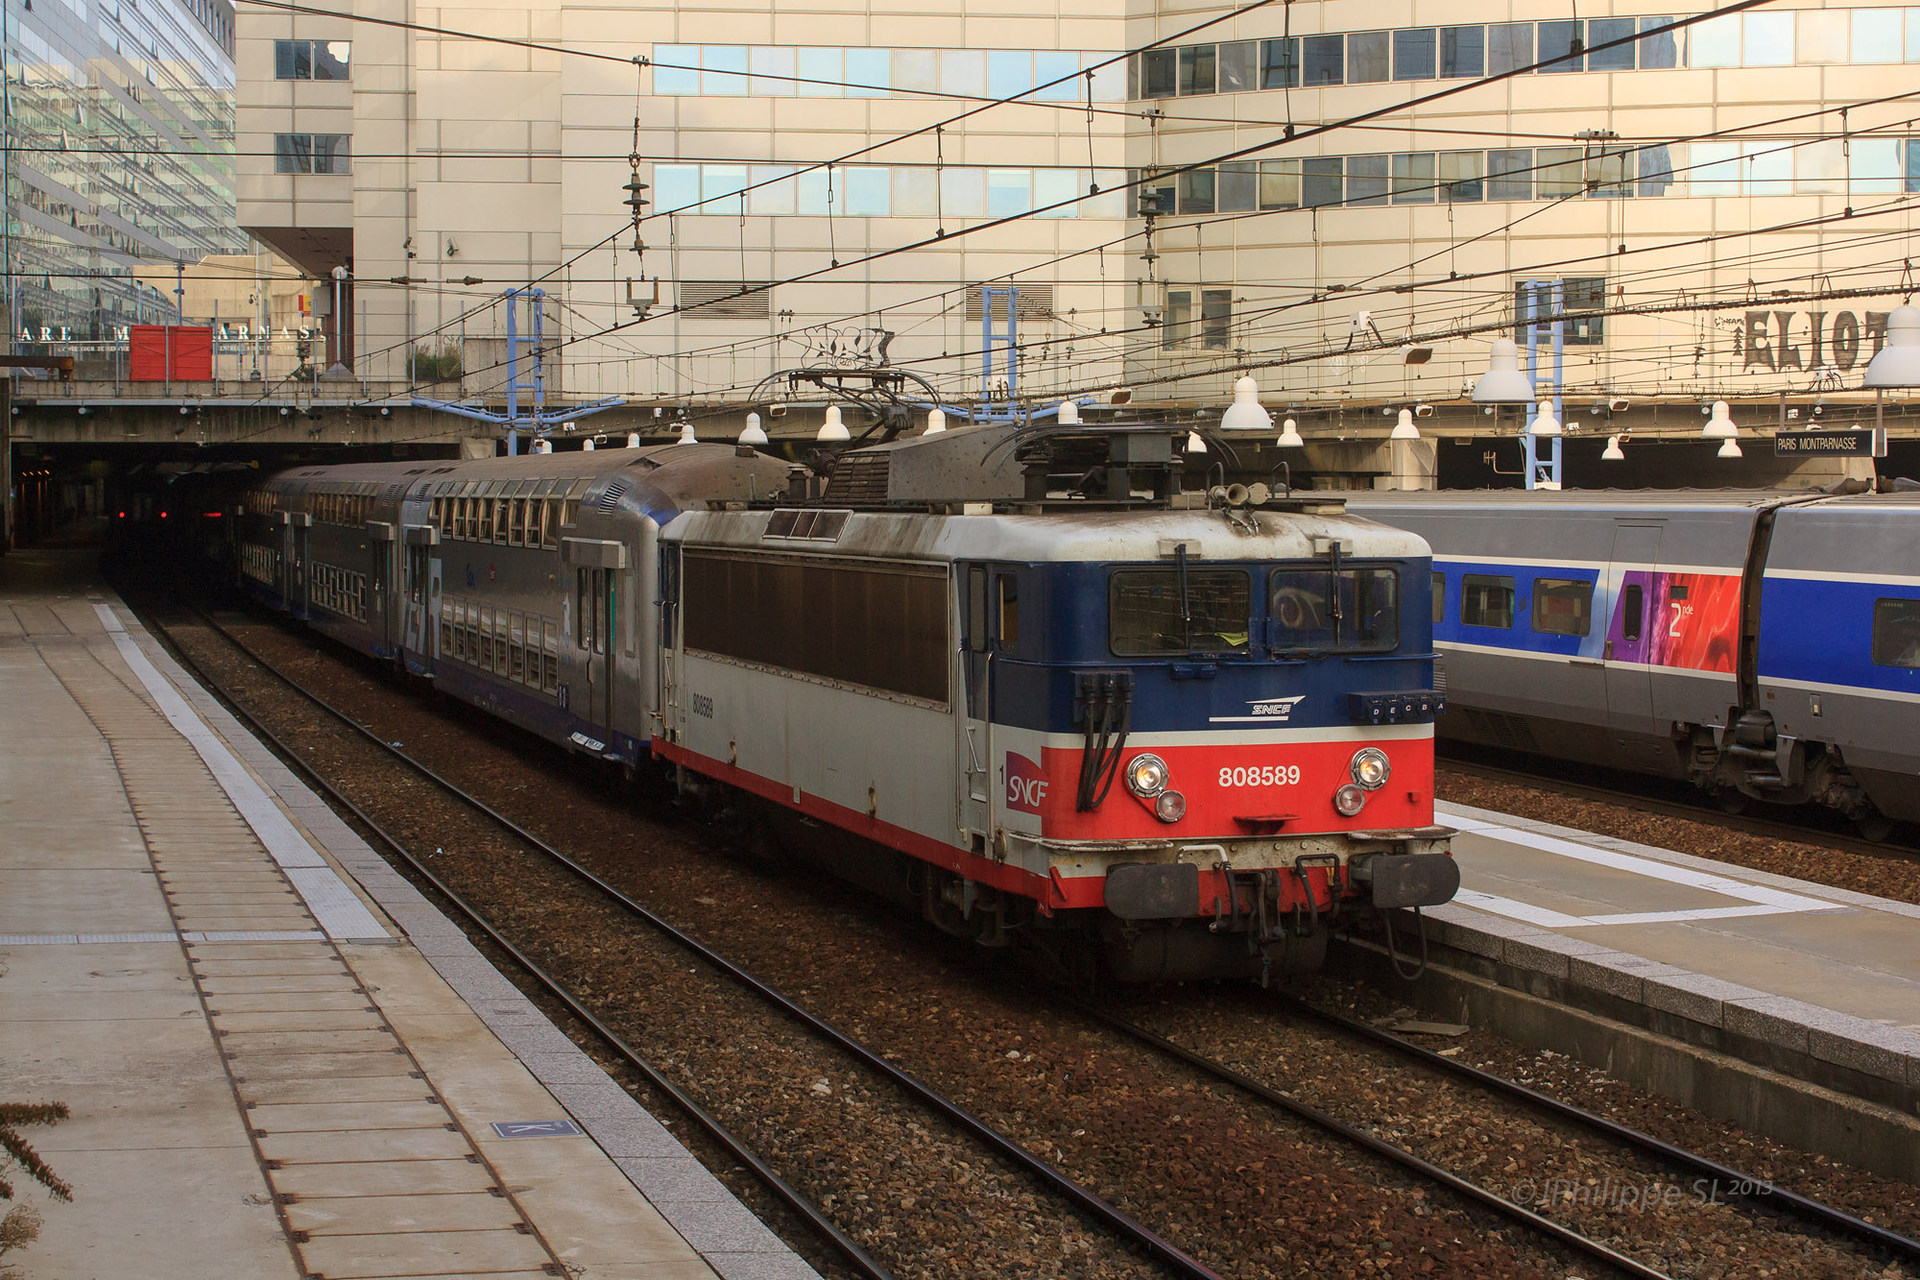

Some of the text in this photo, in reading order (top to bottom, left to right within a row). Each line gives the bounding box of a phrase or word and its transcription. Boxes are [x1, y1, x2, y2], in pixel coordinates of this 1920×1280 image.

[1777, 437, 1857, 451] PARIS MONTPARNASSE
[692, 692, 713, 719] 808589
[1251, 704, 1292, 715] SNCF
[1218, 765, 1300, 787] 808589
[1008, 775, 1049, 807] SNCF
